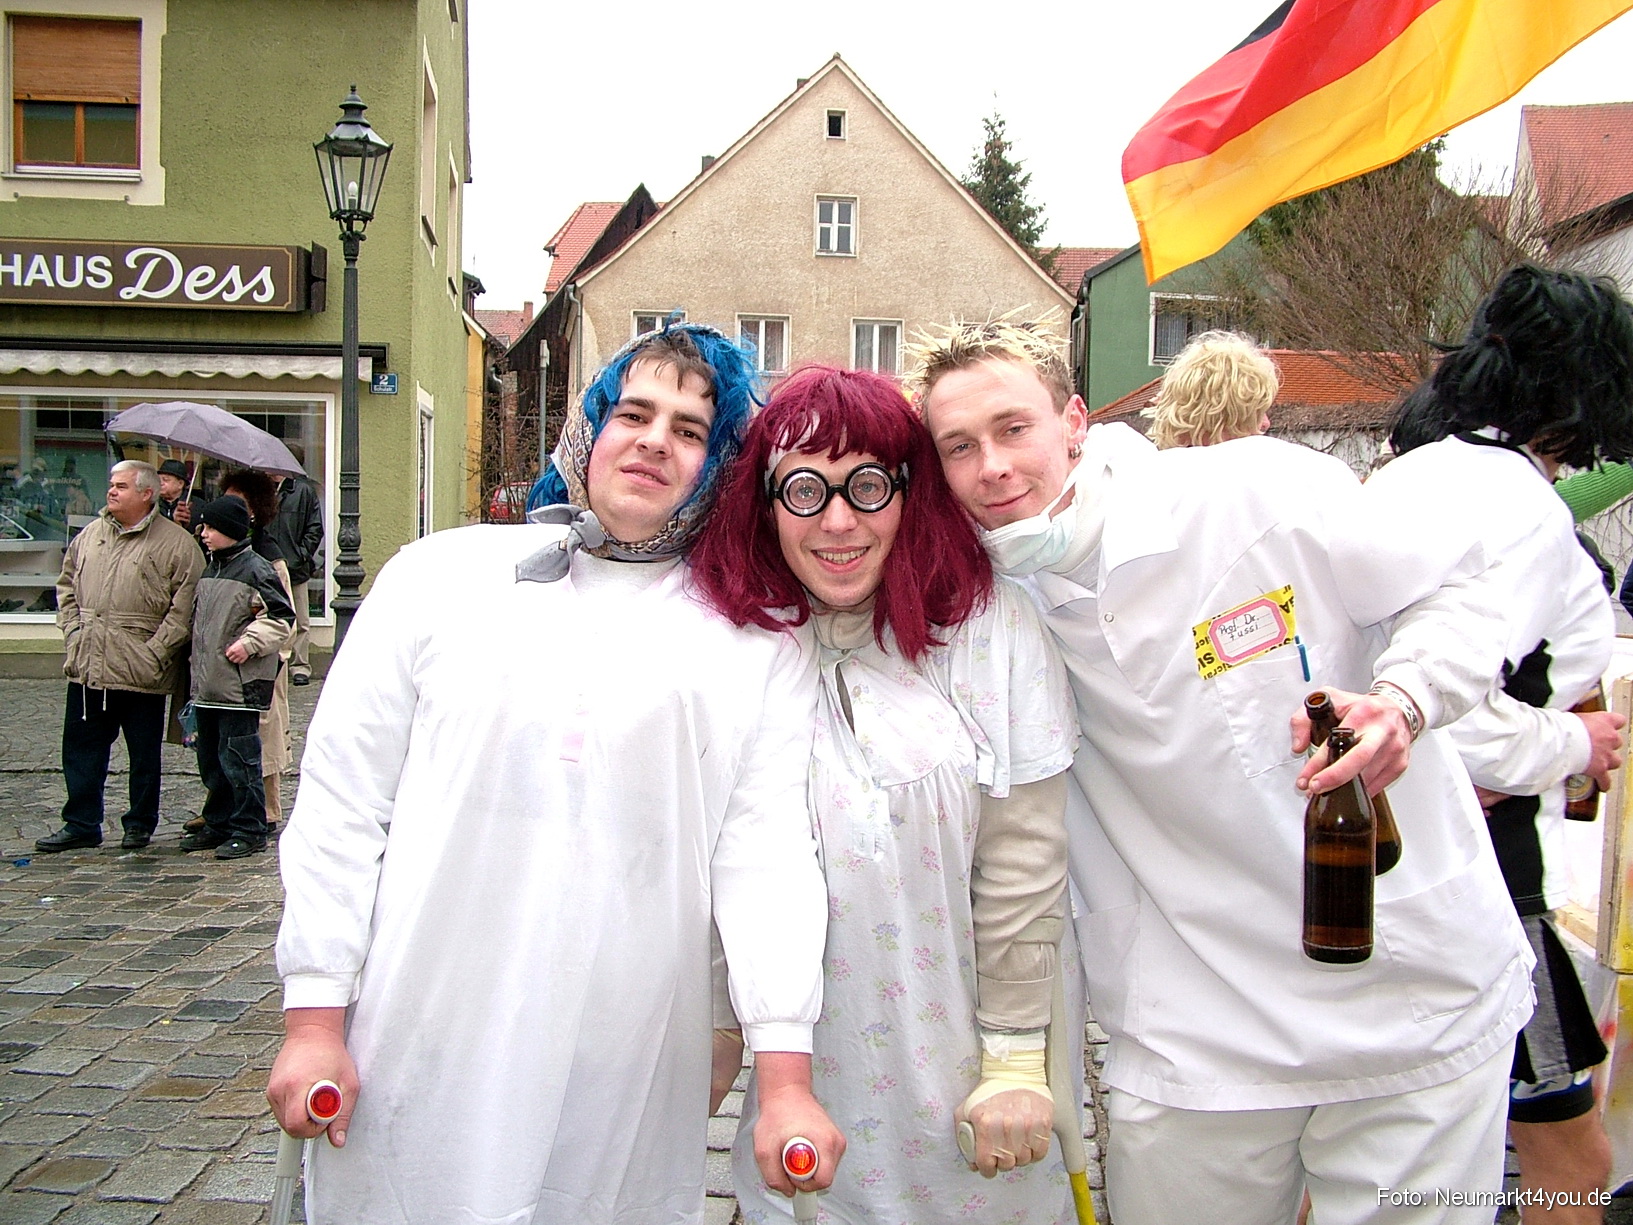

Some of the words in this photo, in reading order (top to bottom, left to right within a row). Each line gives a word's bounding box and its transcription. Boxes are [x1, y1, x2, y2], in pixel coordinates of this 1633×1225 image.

[0, 253, 113, 289] HAUS
[119, 247, 275, 302] Dess
[379, 374, 389, 385] 2
[1245, 613, 1260, 624] Dr.
